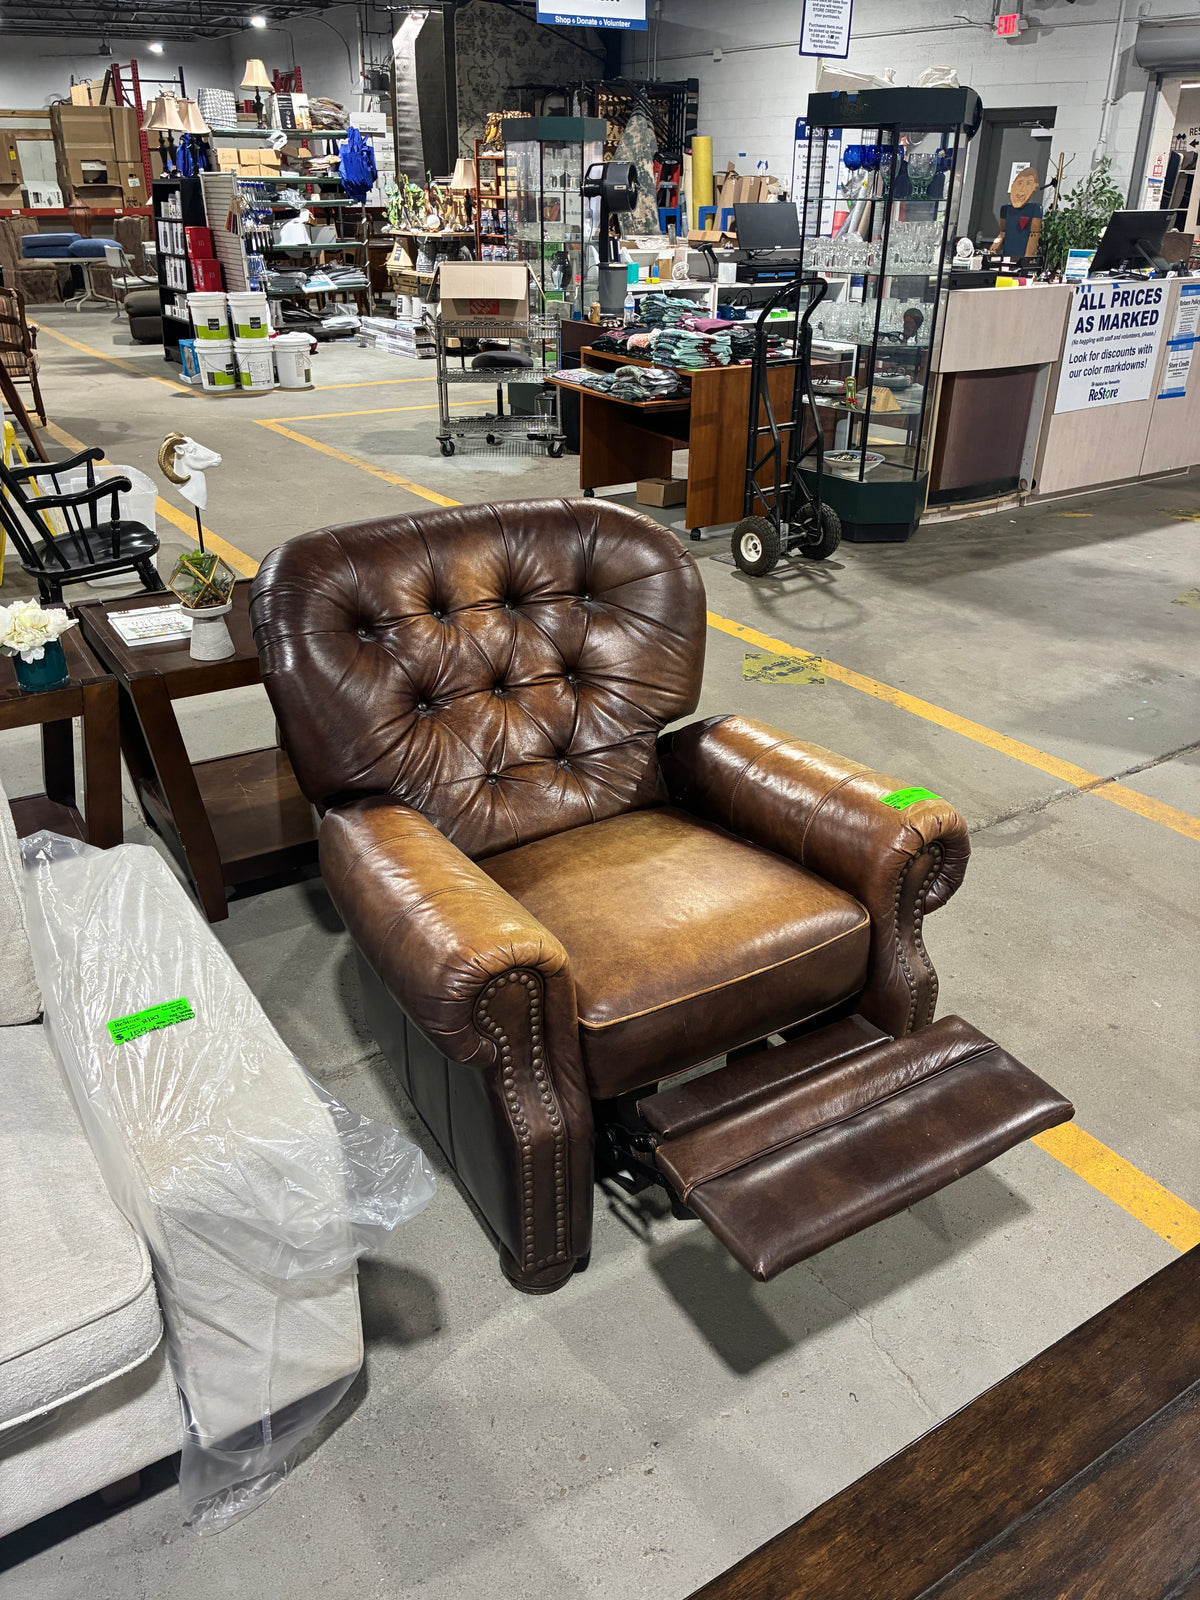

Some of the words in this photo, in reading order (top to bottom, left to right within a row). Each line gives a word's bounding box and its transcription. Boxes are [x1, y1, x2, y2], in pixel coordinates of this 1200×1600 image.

[554, 16, 571, 25] Shop
[576, 17, 598, 26] Donate
[603, 19, 631, 27] Volunteer
[997, 14, 1017, 35] EXIT
[1190, 127, 1200, 136] RE
[1078, 293, 1106, 311] ALL
[1111, 287, 1162, 308] PRICES
[1074, 316, 1095, 334] AS
[1098, 309, 1159, 332] MARKED
[1069, 352, 1087, 364] Look
[1089, 350, 1100, 361] for
[1101, 347, 1136, 360] discounts
[1138, 344, 1153, 354] with
[1069, 369, 1082, 378] our
[1083, 365, 1102, 376] color
[1103, 358, 1148, 374] markdowns!
[1088, 387, 1118, 401] ReStore
